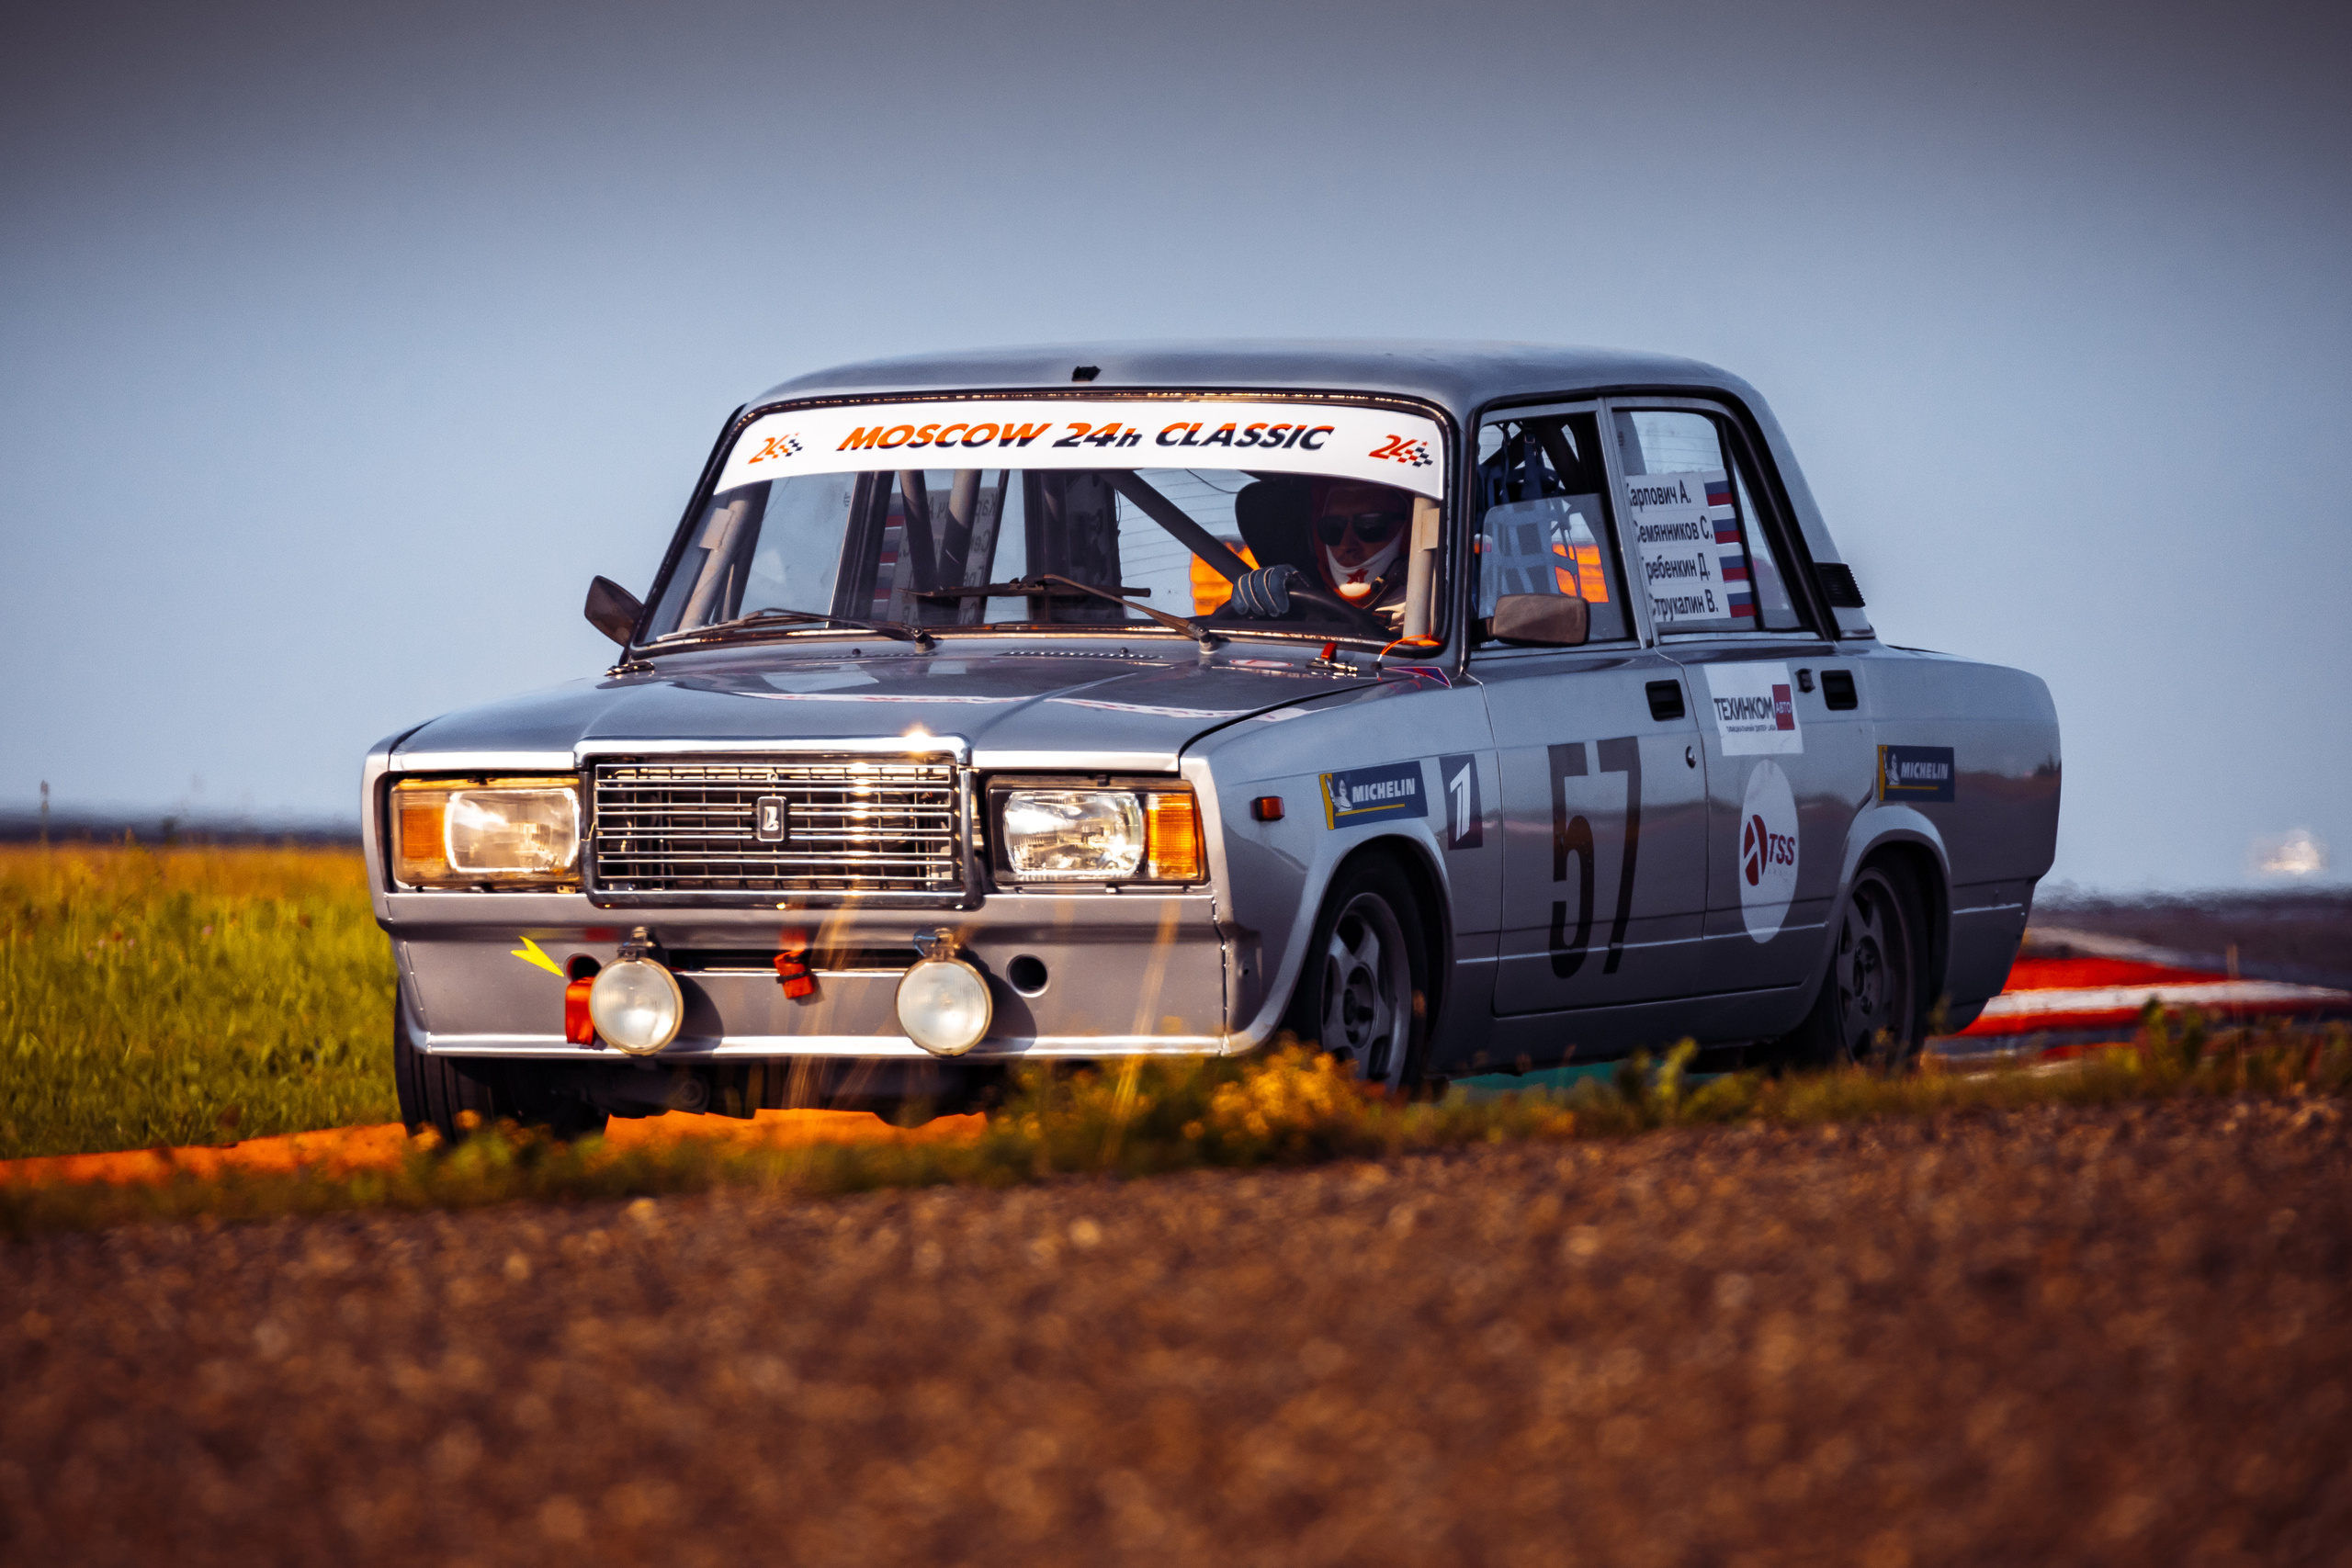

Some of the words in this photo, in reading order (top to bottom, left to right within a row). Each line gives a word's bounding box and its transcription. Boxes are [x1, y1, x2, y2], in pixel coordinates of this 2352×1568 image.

[835, 423, 1054, 451] MOSCOW
[1052, 422, 1144, 448] 24h
[1155, 422, 1336, 451] CLASSIC
[1679, 479, 1691, 504] А.
[1700, 515, 1713, 541] С.
[1641, 555, 1698, 585] ребенкин
[1698, 553, 1711, 581] Д.
[1705, 589, 1719, 613] В.
[1900, 761, 1950, 780] MICHELIN
[1351, 777, 1416, 804] MICHELIN
[1450, 761, 1471, 842] 1
[1547, 736, 1642, 979] 57
[1769, 833, 1795, 866] TSS
